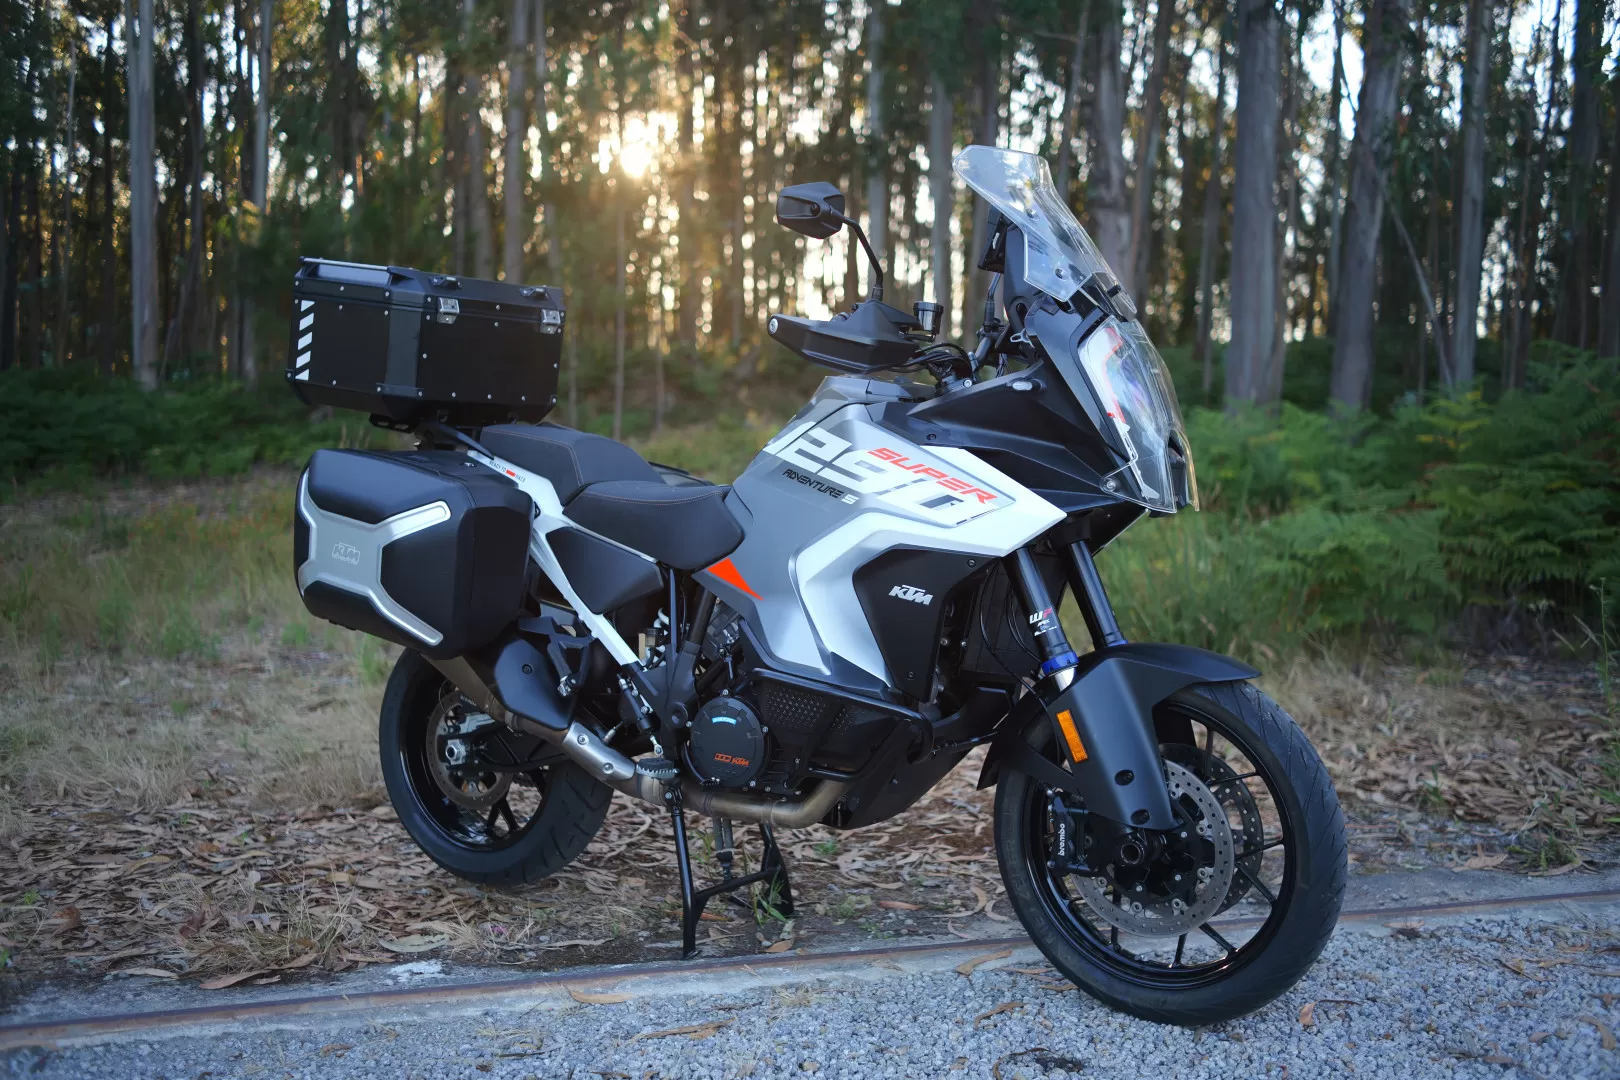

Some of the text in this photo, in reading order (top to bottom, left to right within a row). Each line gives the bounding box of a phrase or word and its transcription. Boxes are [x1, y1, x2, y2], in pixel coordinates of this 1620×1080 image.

[782, 468, 860, 505] ADVENTURE S
[867, 447, 998, 504] SUPER
[332, 542, 361, 566] KTM
[888, 584, 933, 605] KTM
[1029, 607, 1053, 624] WP
[1057, 823, 1066, 856] brembo
